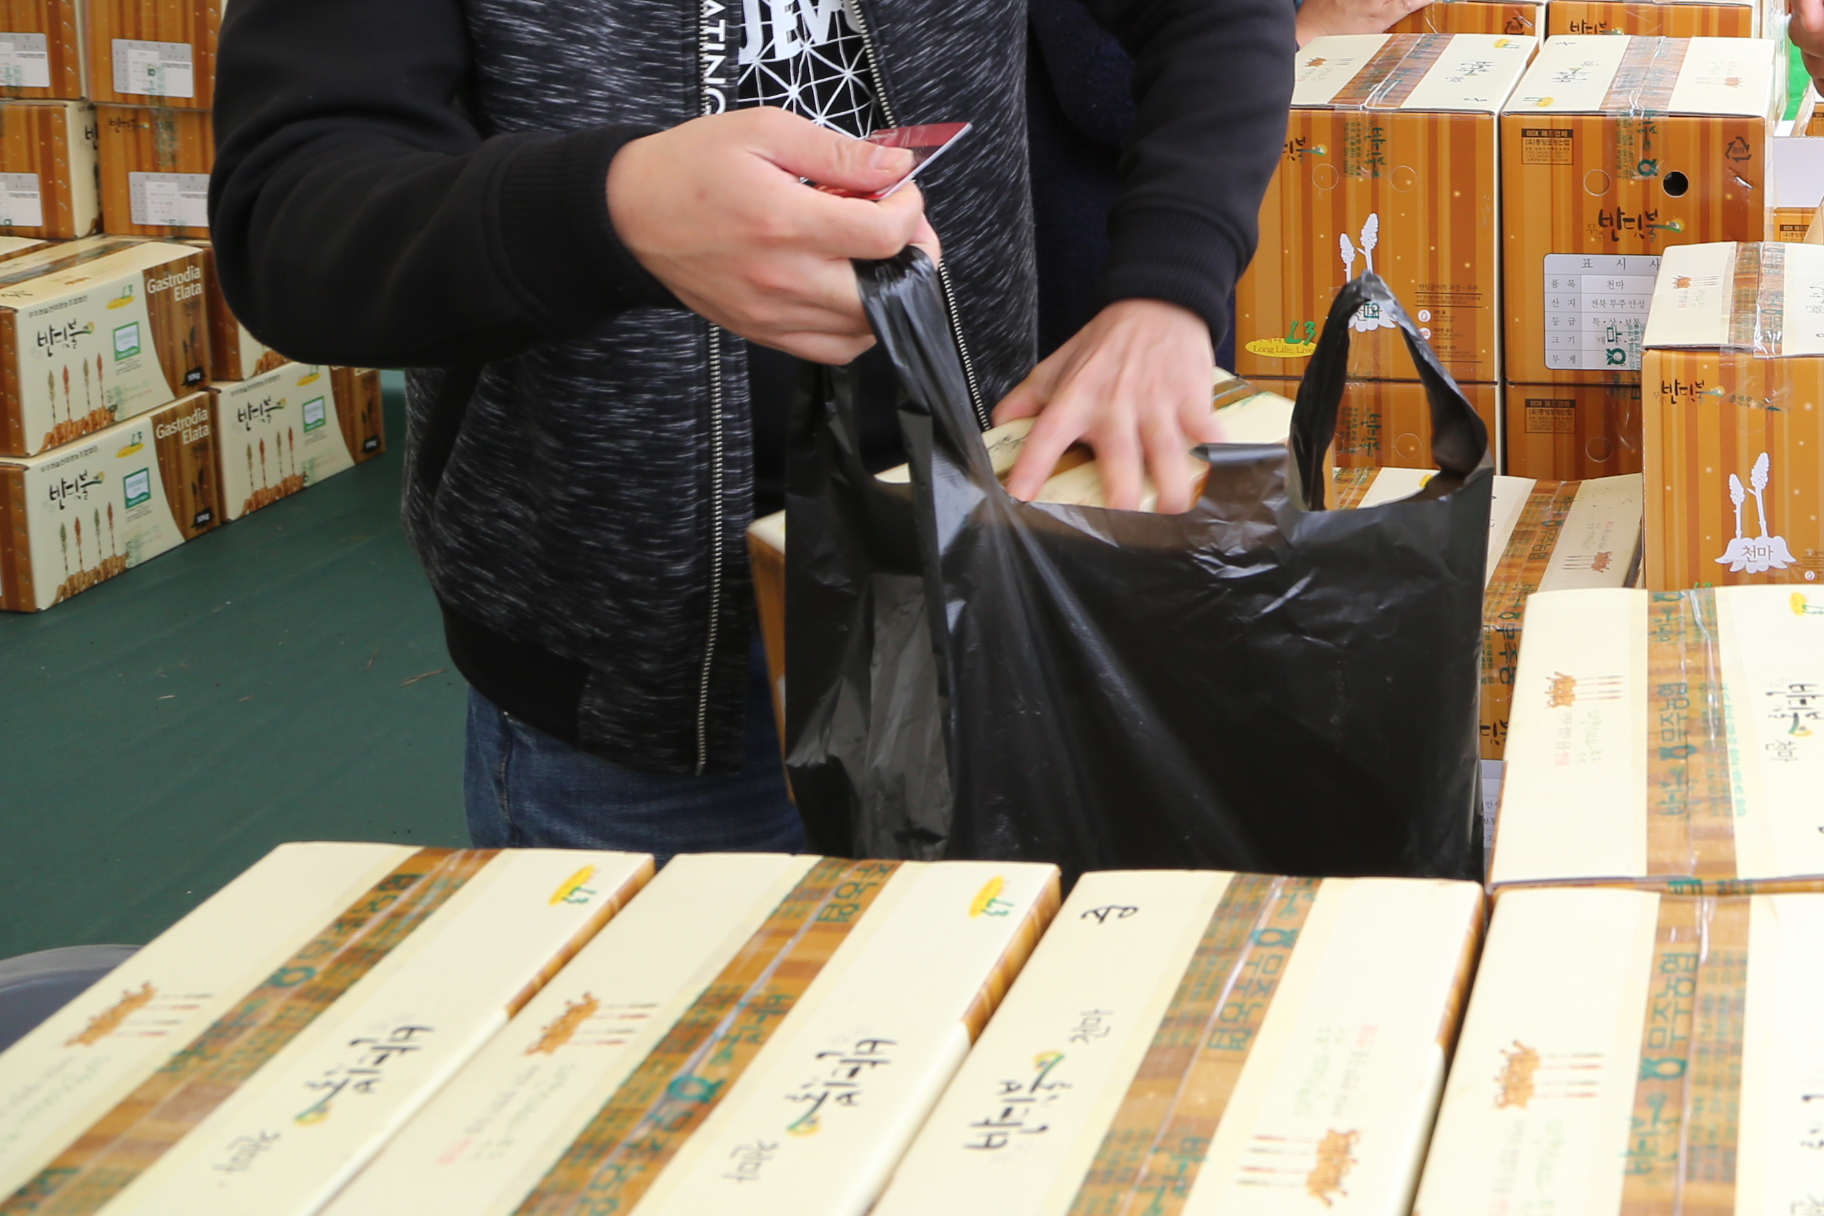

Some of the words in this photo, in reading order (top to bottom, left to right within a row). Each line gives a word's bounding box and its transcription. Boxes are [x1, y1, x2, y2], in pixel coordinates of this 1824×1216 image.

[147, 266, 201, 295] Gastrodia
[174, 282, 202, 302] Elata
[1607, 279, 1625, 290] 천마
[1591, 299, 1607, 309] 전북
[1609, 299, 1626, 309] 무주
[1628, 299, 1645, 309] 안성
[1284, 321, 1316, 346] L3
[1253, 345, 1274, 354] Long
[1276, 345, 1294, 354] Life,
[156, 408, 209, 440] Gastrodia
[182, 424, 210, 445] Elata
[1741, 545, 1774, 562] 천마
[1657, 682, 1691, 742] 무주농협
[1206, 953, 1284, 1052] 무주농협
[1646, 952, 1700, 1050] 무주농협
